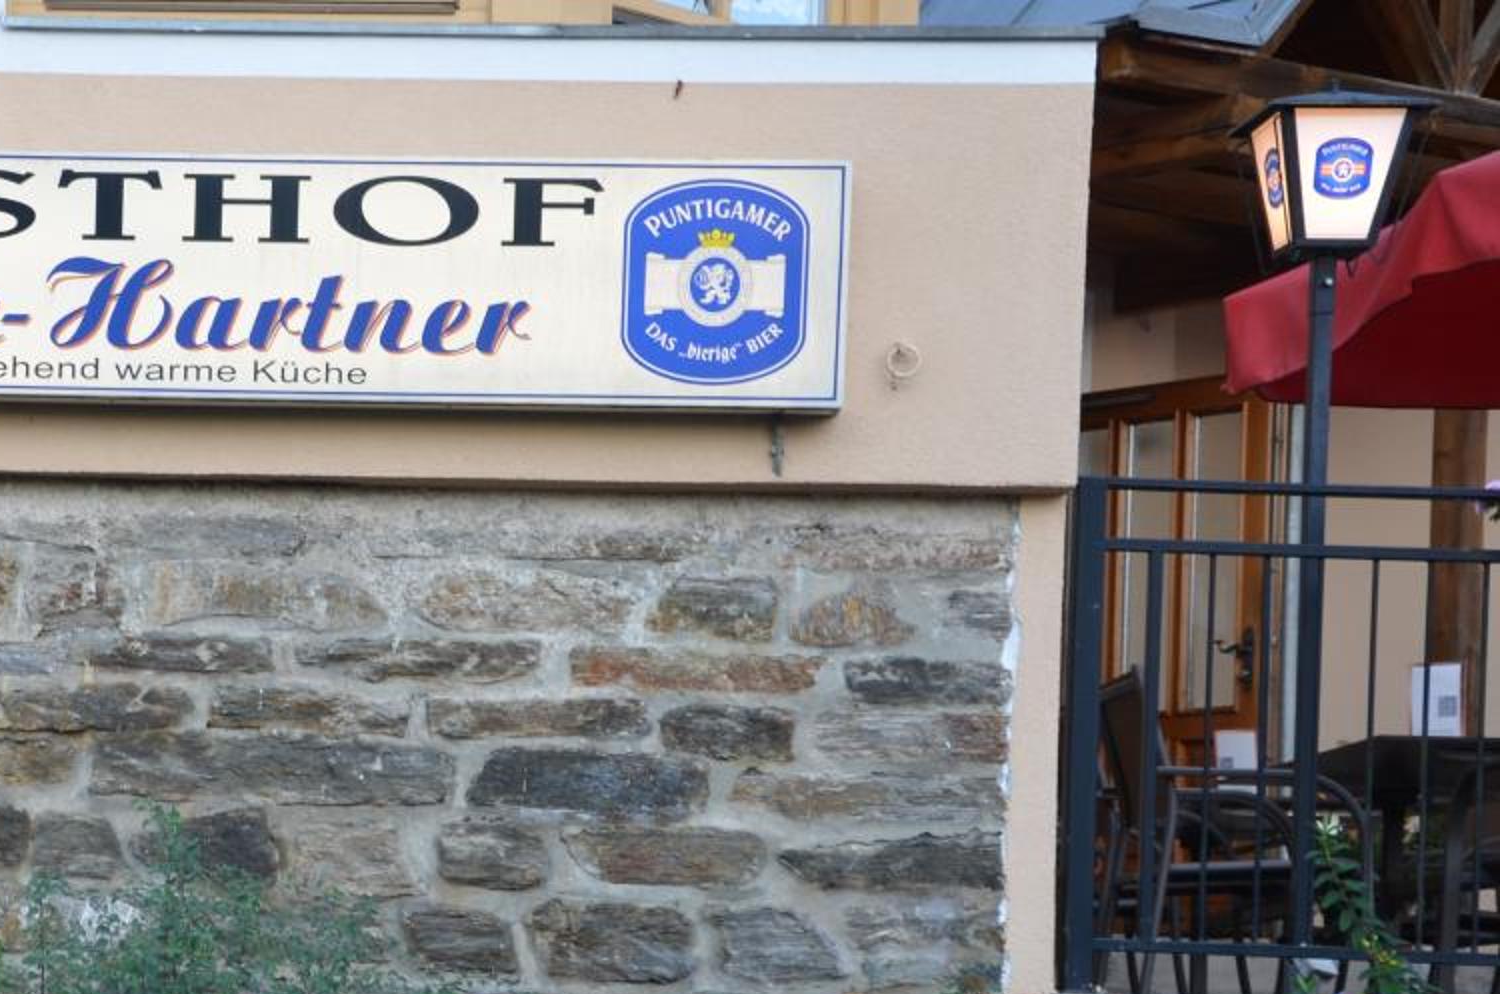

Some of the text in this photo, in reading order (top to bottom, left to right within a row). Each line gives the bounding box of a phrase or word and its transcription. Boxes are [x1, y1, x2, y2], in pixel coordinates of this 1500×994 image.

[643, 198, 792, 242] PUNTIGAMER
[645, 321, 677, 352] DAS
[745, 322, 784, 355] BIER
[115, 362, 237, 383] warme
[252, 359, 368, 385] Küche
